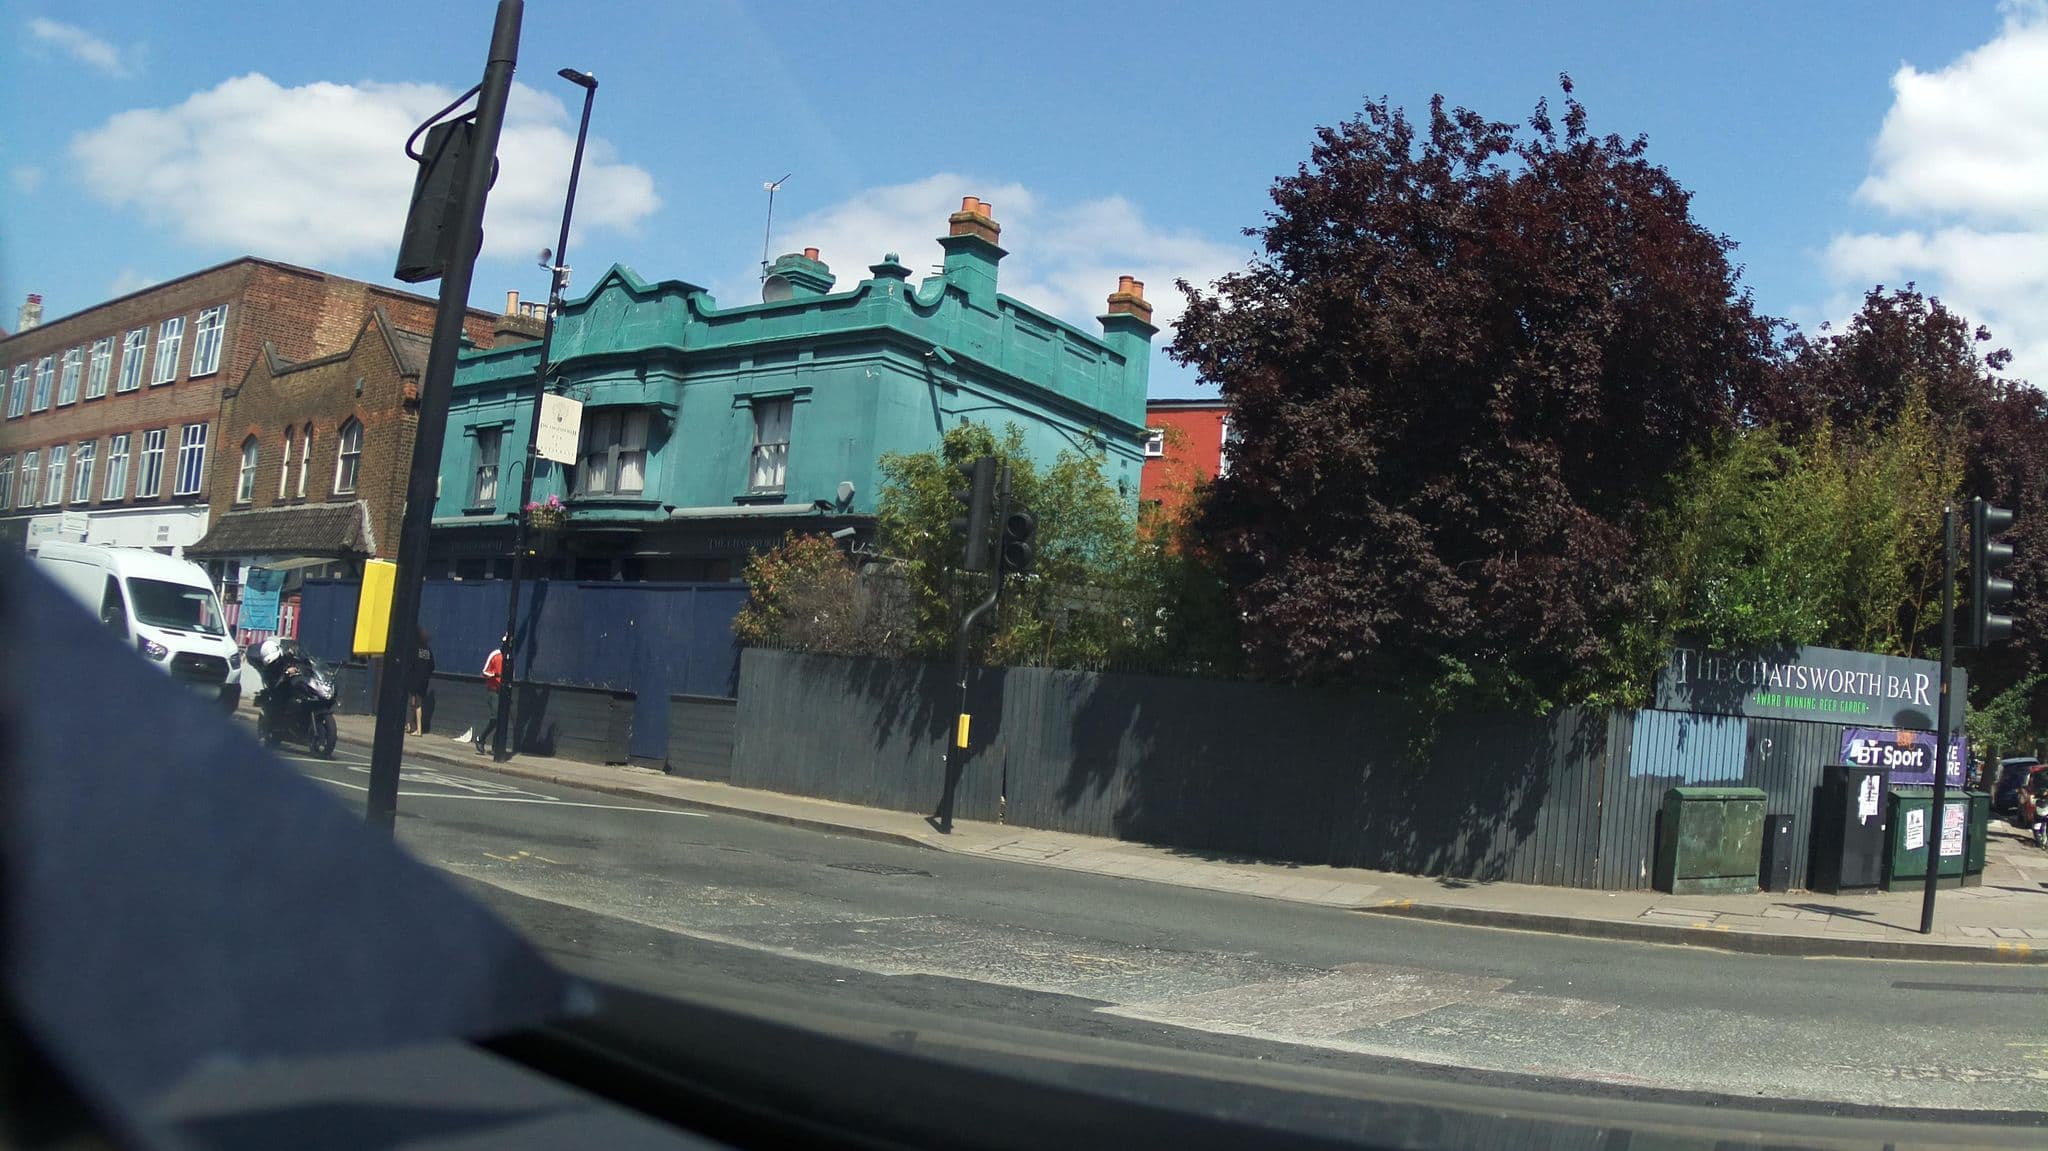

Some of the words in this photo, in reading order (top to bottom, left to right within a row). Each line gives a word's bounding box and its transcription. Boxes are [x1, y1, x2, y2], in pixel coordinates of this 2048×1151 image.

[1673, 647, 1729, 684] THE
[1735, 659, 1882, 697] CHATSWORTH
[1887, 673, 1931, 706] BAR
[1756, 692, 1781, 708] AWARD
[1784, 695, 1816, 711] WINNING
[1857, 746, 1883, 764] BT
[1883, 745, 1924, 769] Sport
